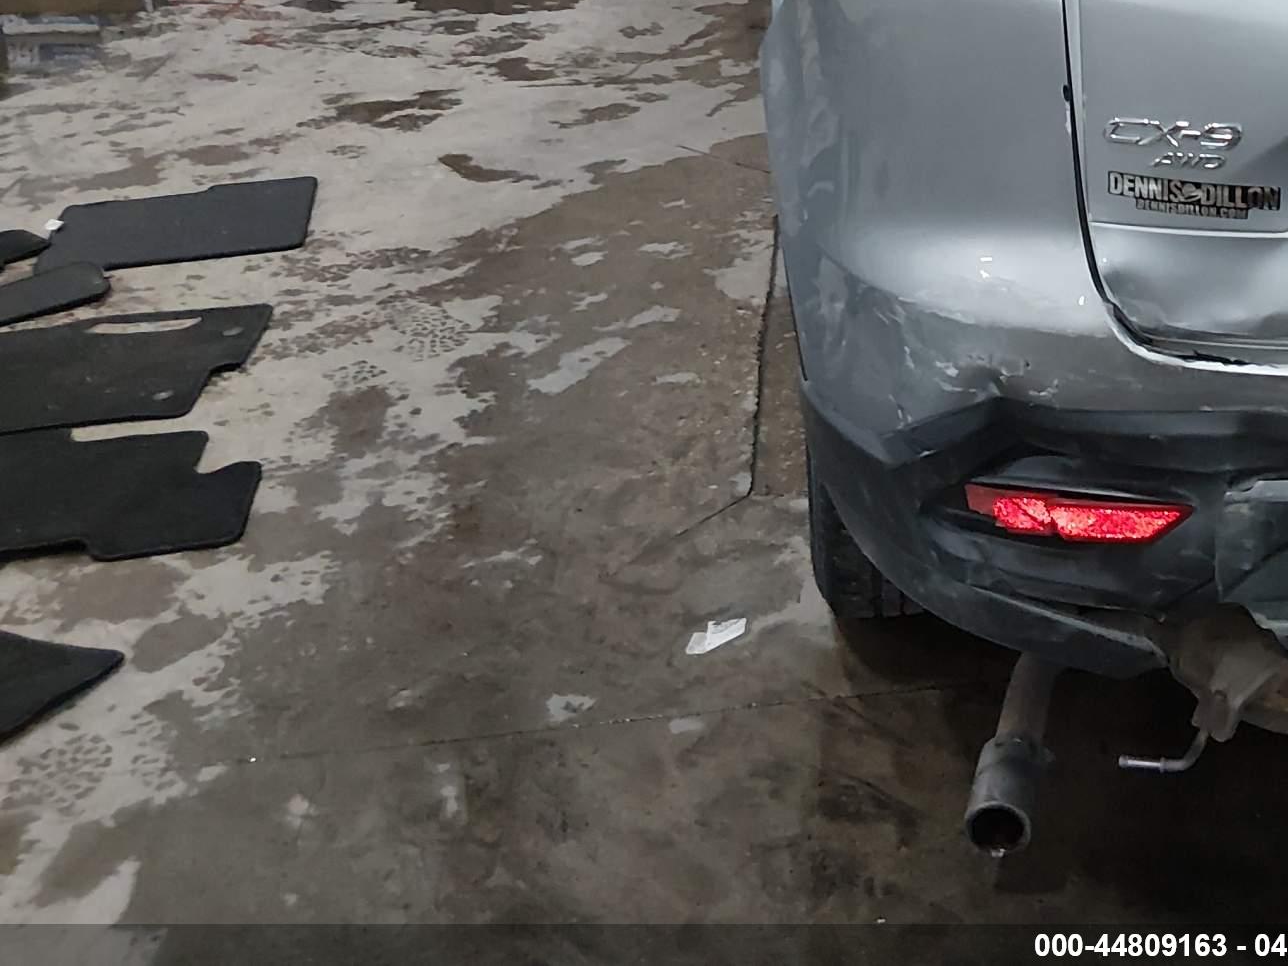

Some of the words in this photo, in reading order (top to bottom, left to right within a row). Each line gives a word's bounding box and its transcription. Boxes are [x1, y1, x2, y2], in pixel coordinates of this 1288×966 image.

[1103, 117, 1243, 151] CX-9
[1149, 151, 1227, 170] AWD
[1108, 172, 1182, 202] DENNIS
[1199, 182, 1281, 211] DILLON
[1136, 198, 1248, 219] DENNISDILLON.COM
